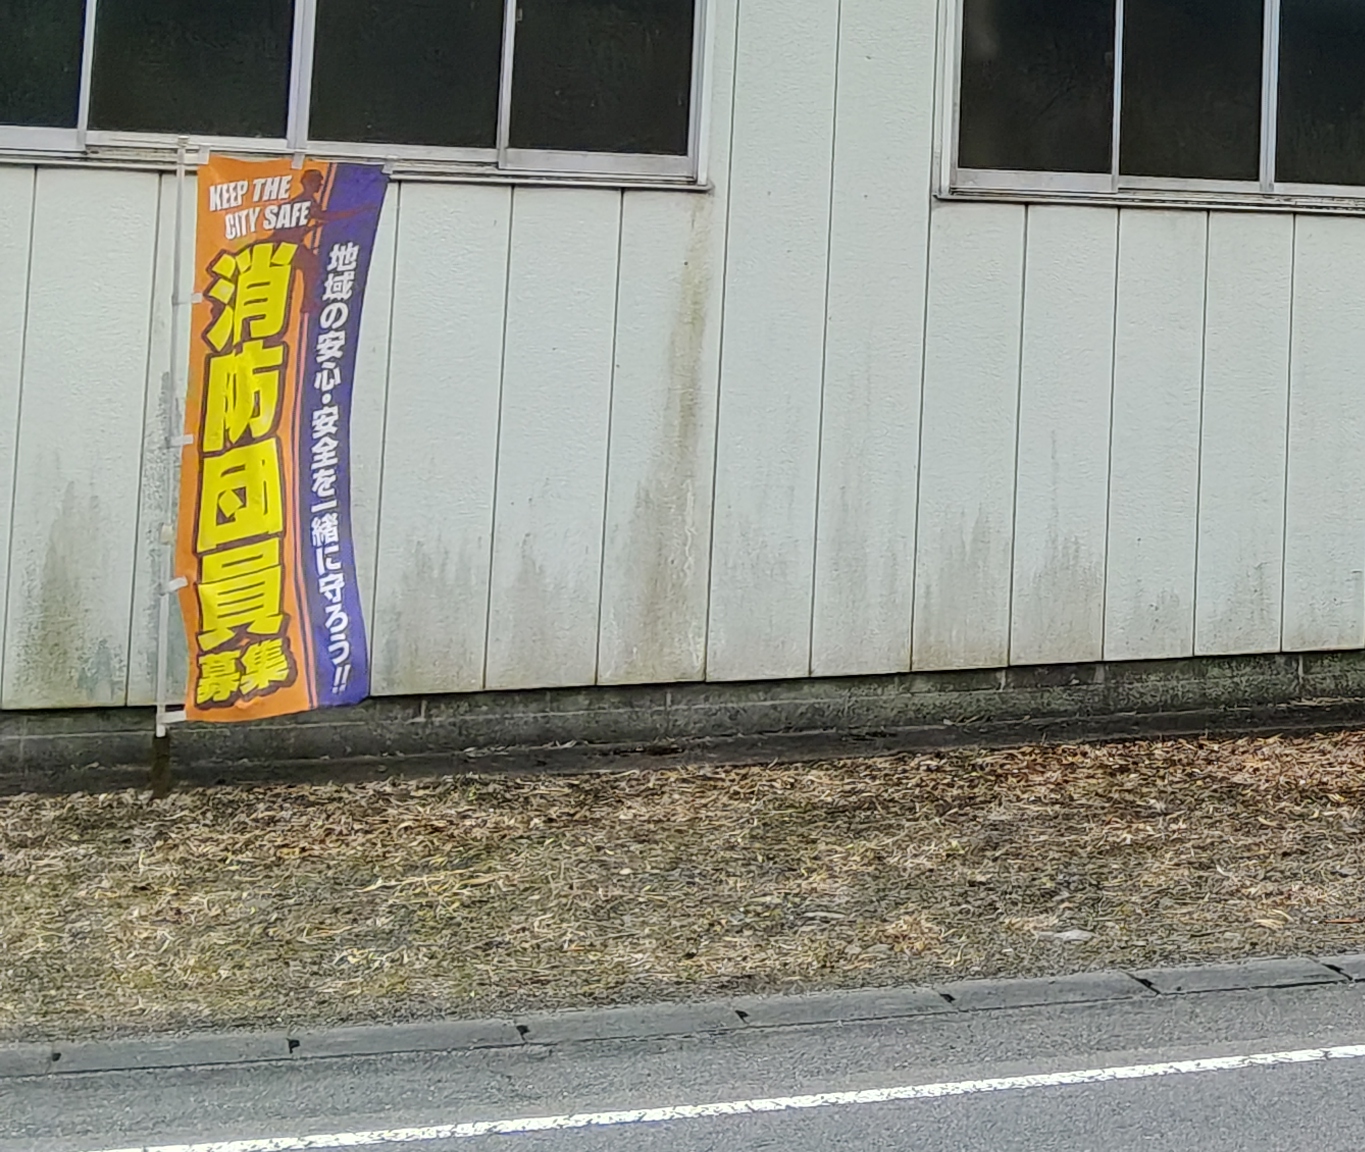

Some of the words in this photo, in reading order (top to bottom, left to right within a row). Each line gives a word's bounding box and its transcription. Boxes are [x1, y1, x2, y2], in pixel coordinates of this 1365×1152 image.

[209, 180, 248, 212] KEEP
[252, 175, 293, 202] THE
[225, 207, 261, 240] CITY
[263, 201, 312, 230] SAFE
